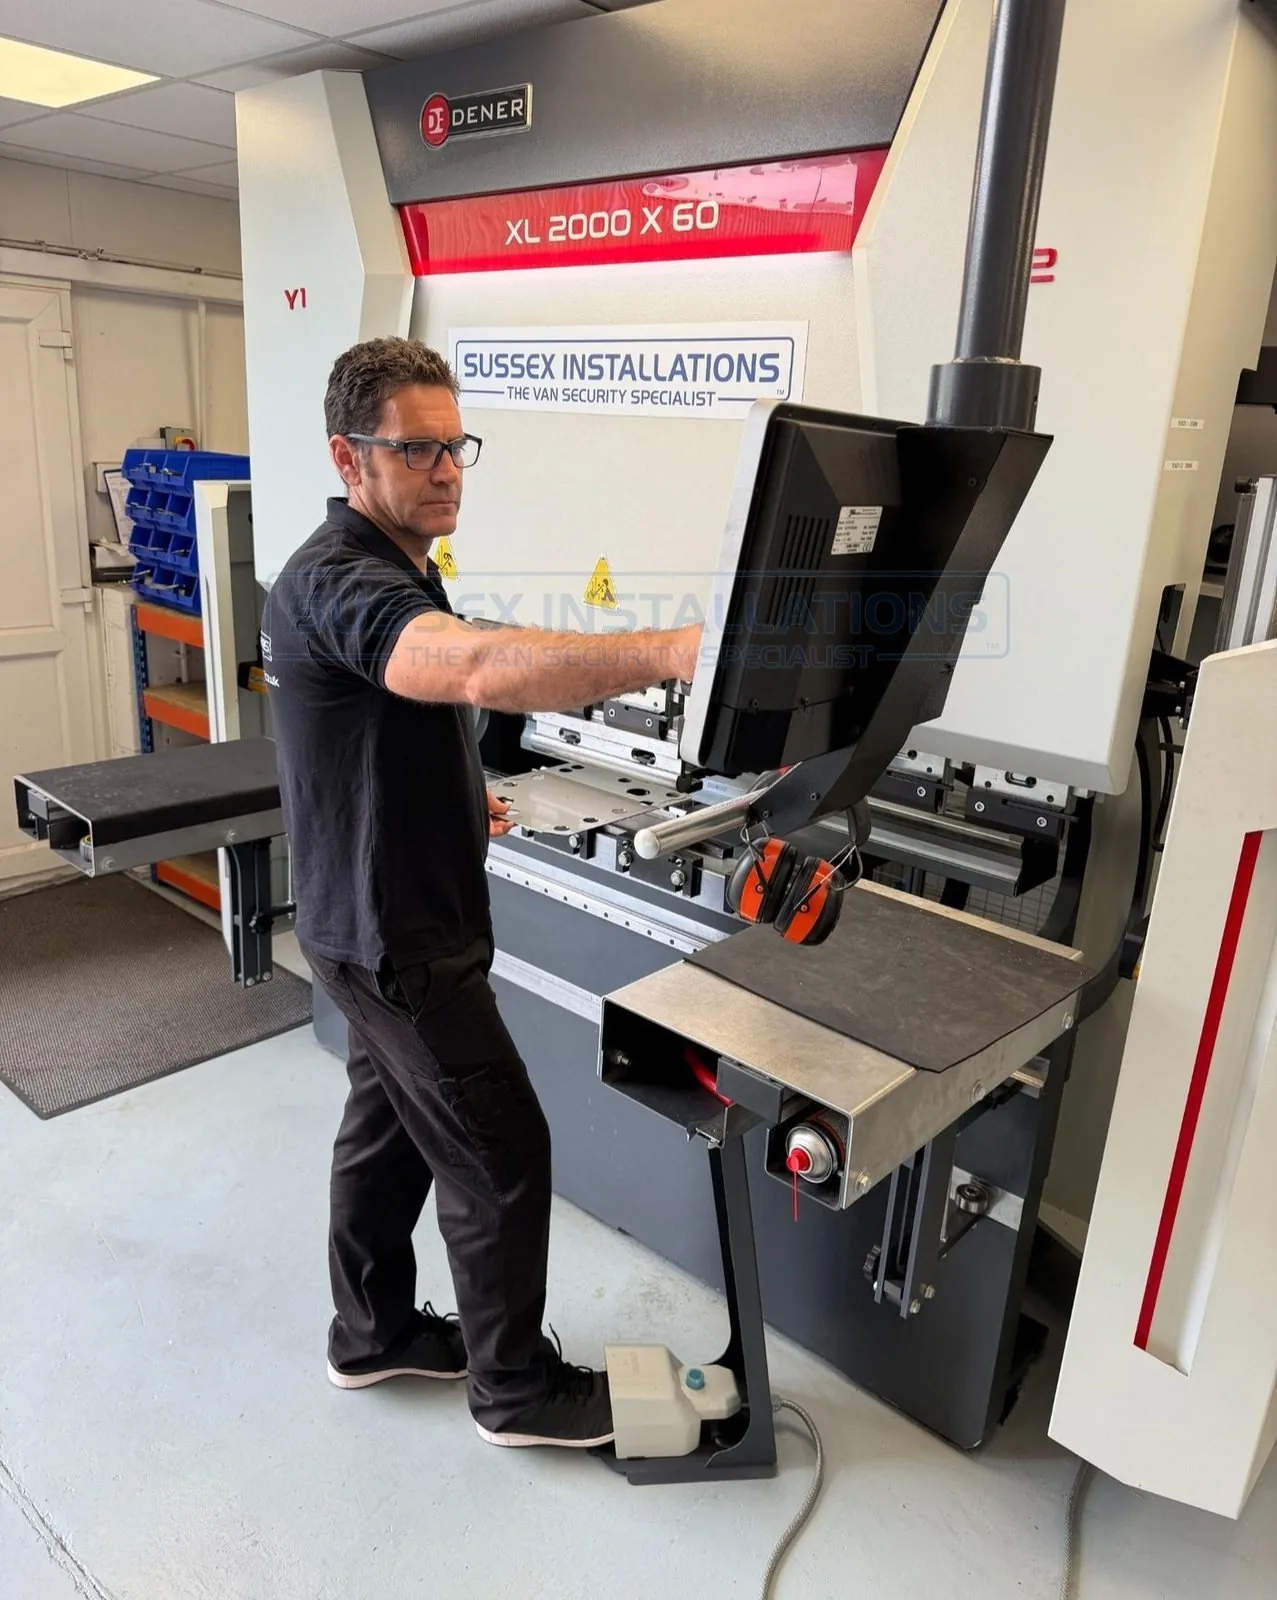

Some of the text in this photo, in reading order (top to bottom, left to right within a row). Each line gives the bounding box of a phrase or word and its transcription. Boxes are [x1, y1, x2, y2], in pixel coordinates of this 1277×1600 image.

[452, 98, 523, 126] DENER
[505, 200, 719, 245] XL 2000 X 60
[284, 287, 306, 310] Y1
[463, 352, 780, 383] SUSSEX INSTALLATIONS
[507, 386, 716, 407] THE VAN SECURITY SPECIALIST
